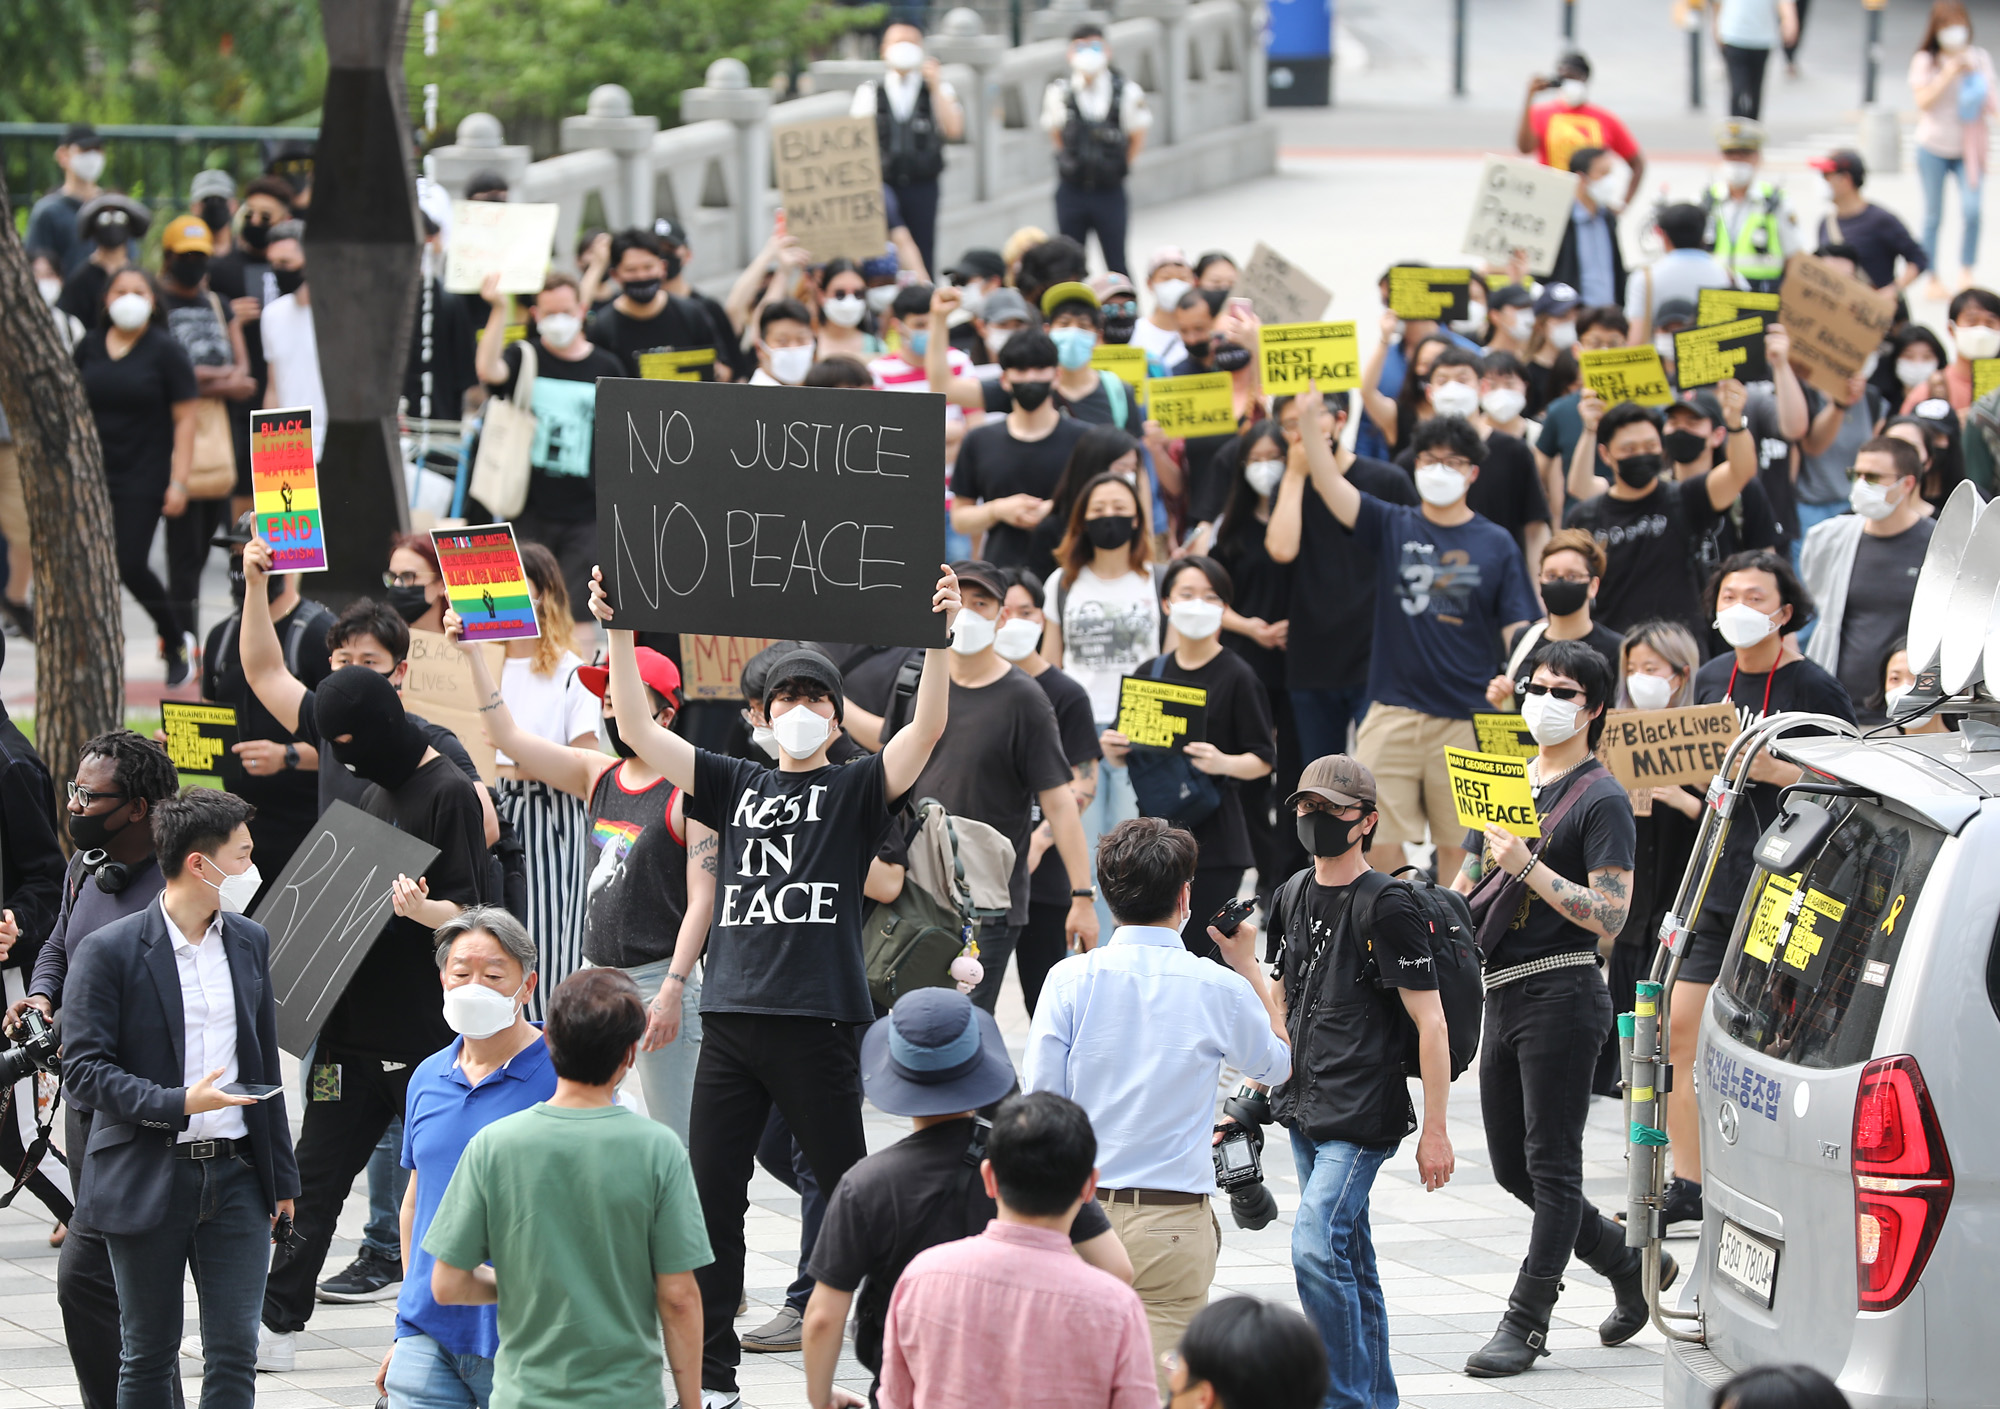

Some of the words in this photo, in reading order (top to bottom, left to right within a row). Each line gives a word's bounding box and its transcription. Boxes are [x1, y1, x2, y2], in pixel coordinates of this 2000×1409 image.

[780, 126, 870, 161] BLACK
[783, 158, 876, 192] LIVES
[786, 190, 884, 226] MATTER
[1266, 347, 1316, 365] REST
[1268, 364, 1288, 383] IN
[1293, 361, 1358, 381] PEACE
[1611, 381, 1665, 401] PEACE
[261, 420, 303, 437] BLACK
[1177, 409, 1231, 426] PEACE
[262, 440, 305, 460] LIVES
[627, 410, 694, 474] NO
[730, 419, 910, 478] JUSTICE
[263, 464, 306, 478] MATTER
[266, 515, 312, 542] END
[272, 547, 315, 561] RACISM
[613, 502, 708, 610] NO
[727, 510, 905, 598] PEACE
[489, 565, 521, 583] MATTER
[411, 639, 469, 669] BLACK
[409, 669, 457, 692] LIVES
[1125, 683, 1137, 691] WE
[1140, 685, 1174, 696] AGAINST
[1177, 691, 1206, 702] RACISM
[164, 708, 176, 717] WE
[177, 710, 207, 719] AGAINST
[208, 711, 236, 721] RACISM
[1449, 754, 1465, 768] MAY
[1465, 758, 1496, 773] GEORGE
[1495, 763, 1524, 776] FLOYD
[1454, 776, 1490, 801] REST
[1458, 796, 1474, 816] IN
[1475, 800, 1534, 824] PEACE
[736, 833, 796, 877] IN
[718, 882, 840, 928] EACE
[1706, 1043, 1782, 1122] 국건설노동조합
[20, 1160, 35, 1183] anon
[1743, 1243, 1771, 1290] 7804
